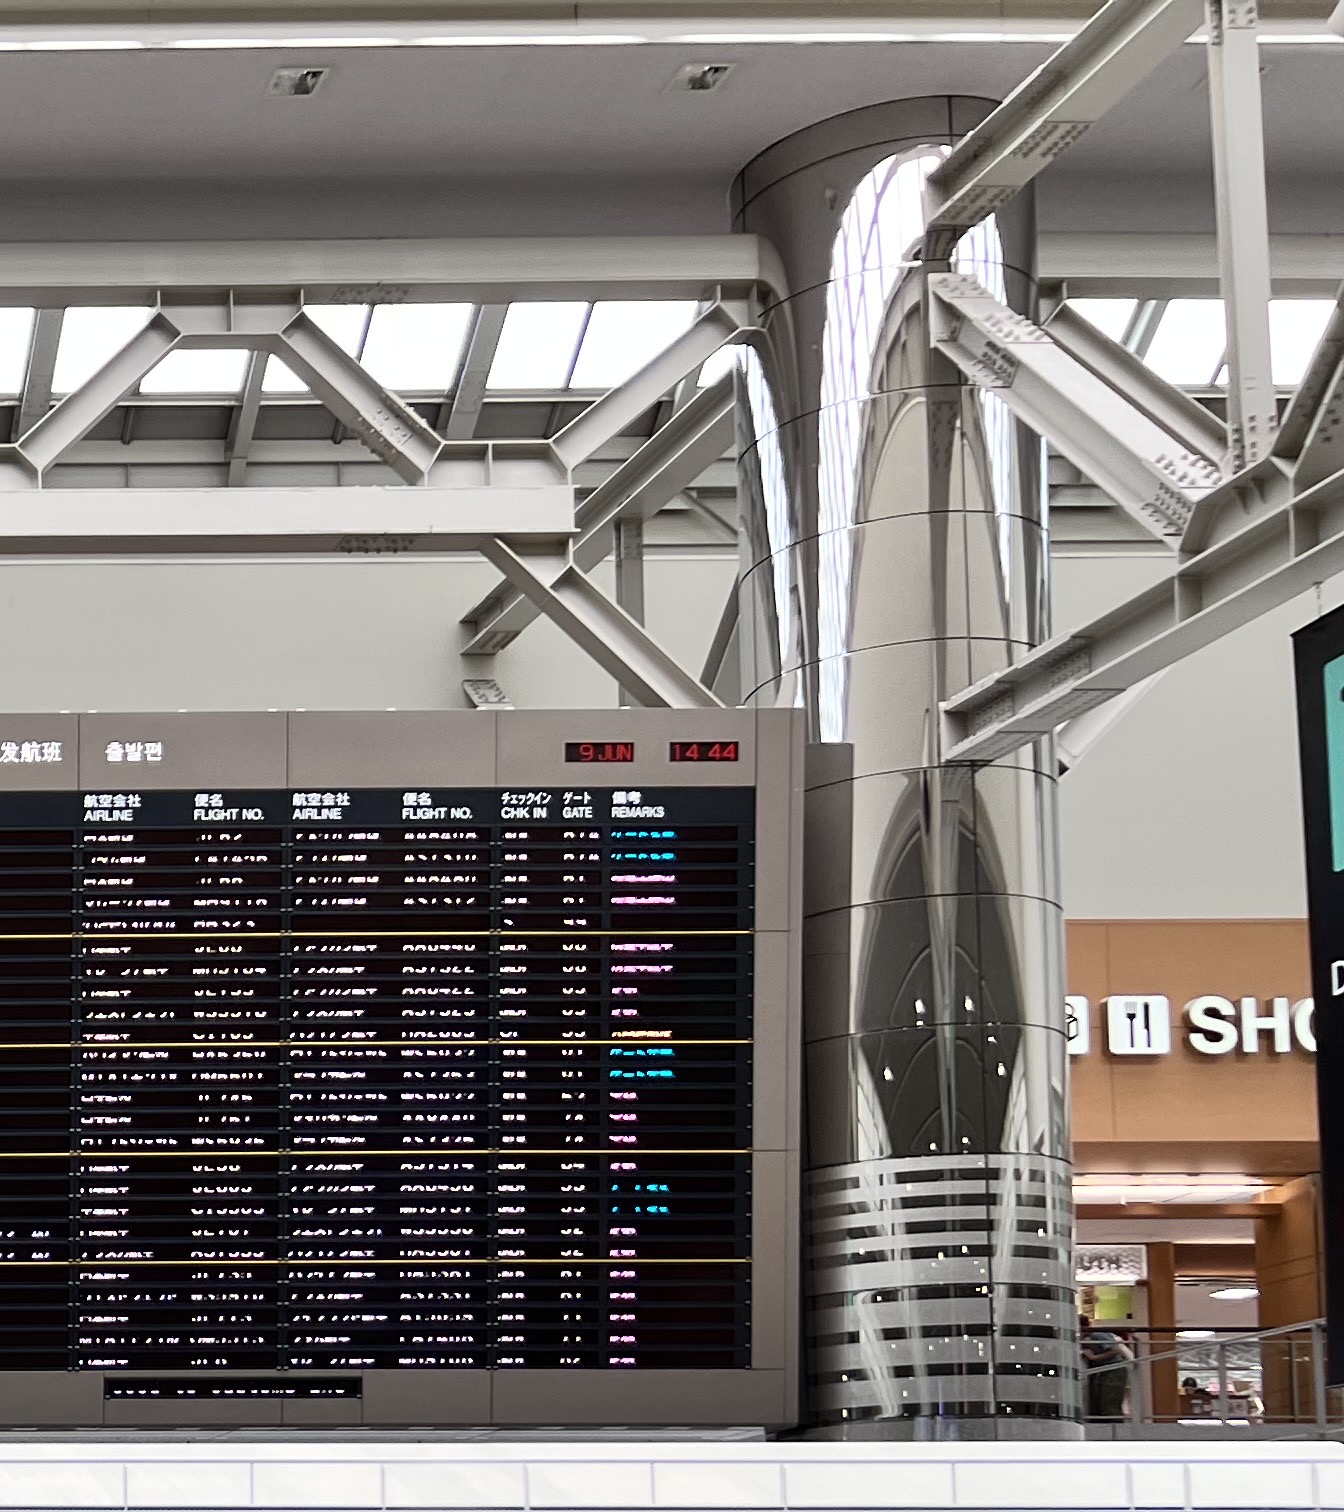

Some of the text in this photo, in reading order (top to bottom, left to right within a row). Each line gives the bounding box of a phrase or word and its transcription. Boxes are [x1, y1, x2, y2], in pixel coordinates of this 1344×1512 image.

[104, 741, 163, 762] 출발편
[598, 744, 631, 761] JUN
[84, 794, 141, 808] 航空会社
[194, 793, 223, 807] 便名
[292, 792, 350, 806] 航空会社
[403, 792, 431, 806] 便名
[501, 792, 551, 804] チェックイン
[562, 792, 591, 804] ゲート
[84, 809, 133, 821] AIRLINE
[194, 808, 264, 820] FLIGHT NO.
[292, 808, 341, 820] AIRLINE
[402, 807, 473, 819] FLIGHT NO.
[501, 807, 546, 818] CHK IN
[563, 806, 593, 818] GATE
[611, 806, 664, 818] REMARKS
